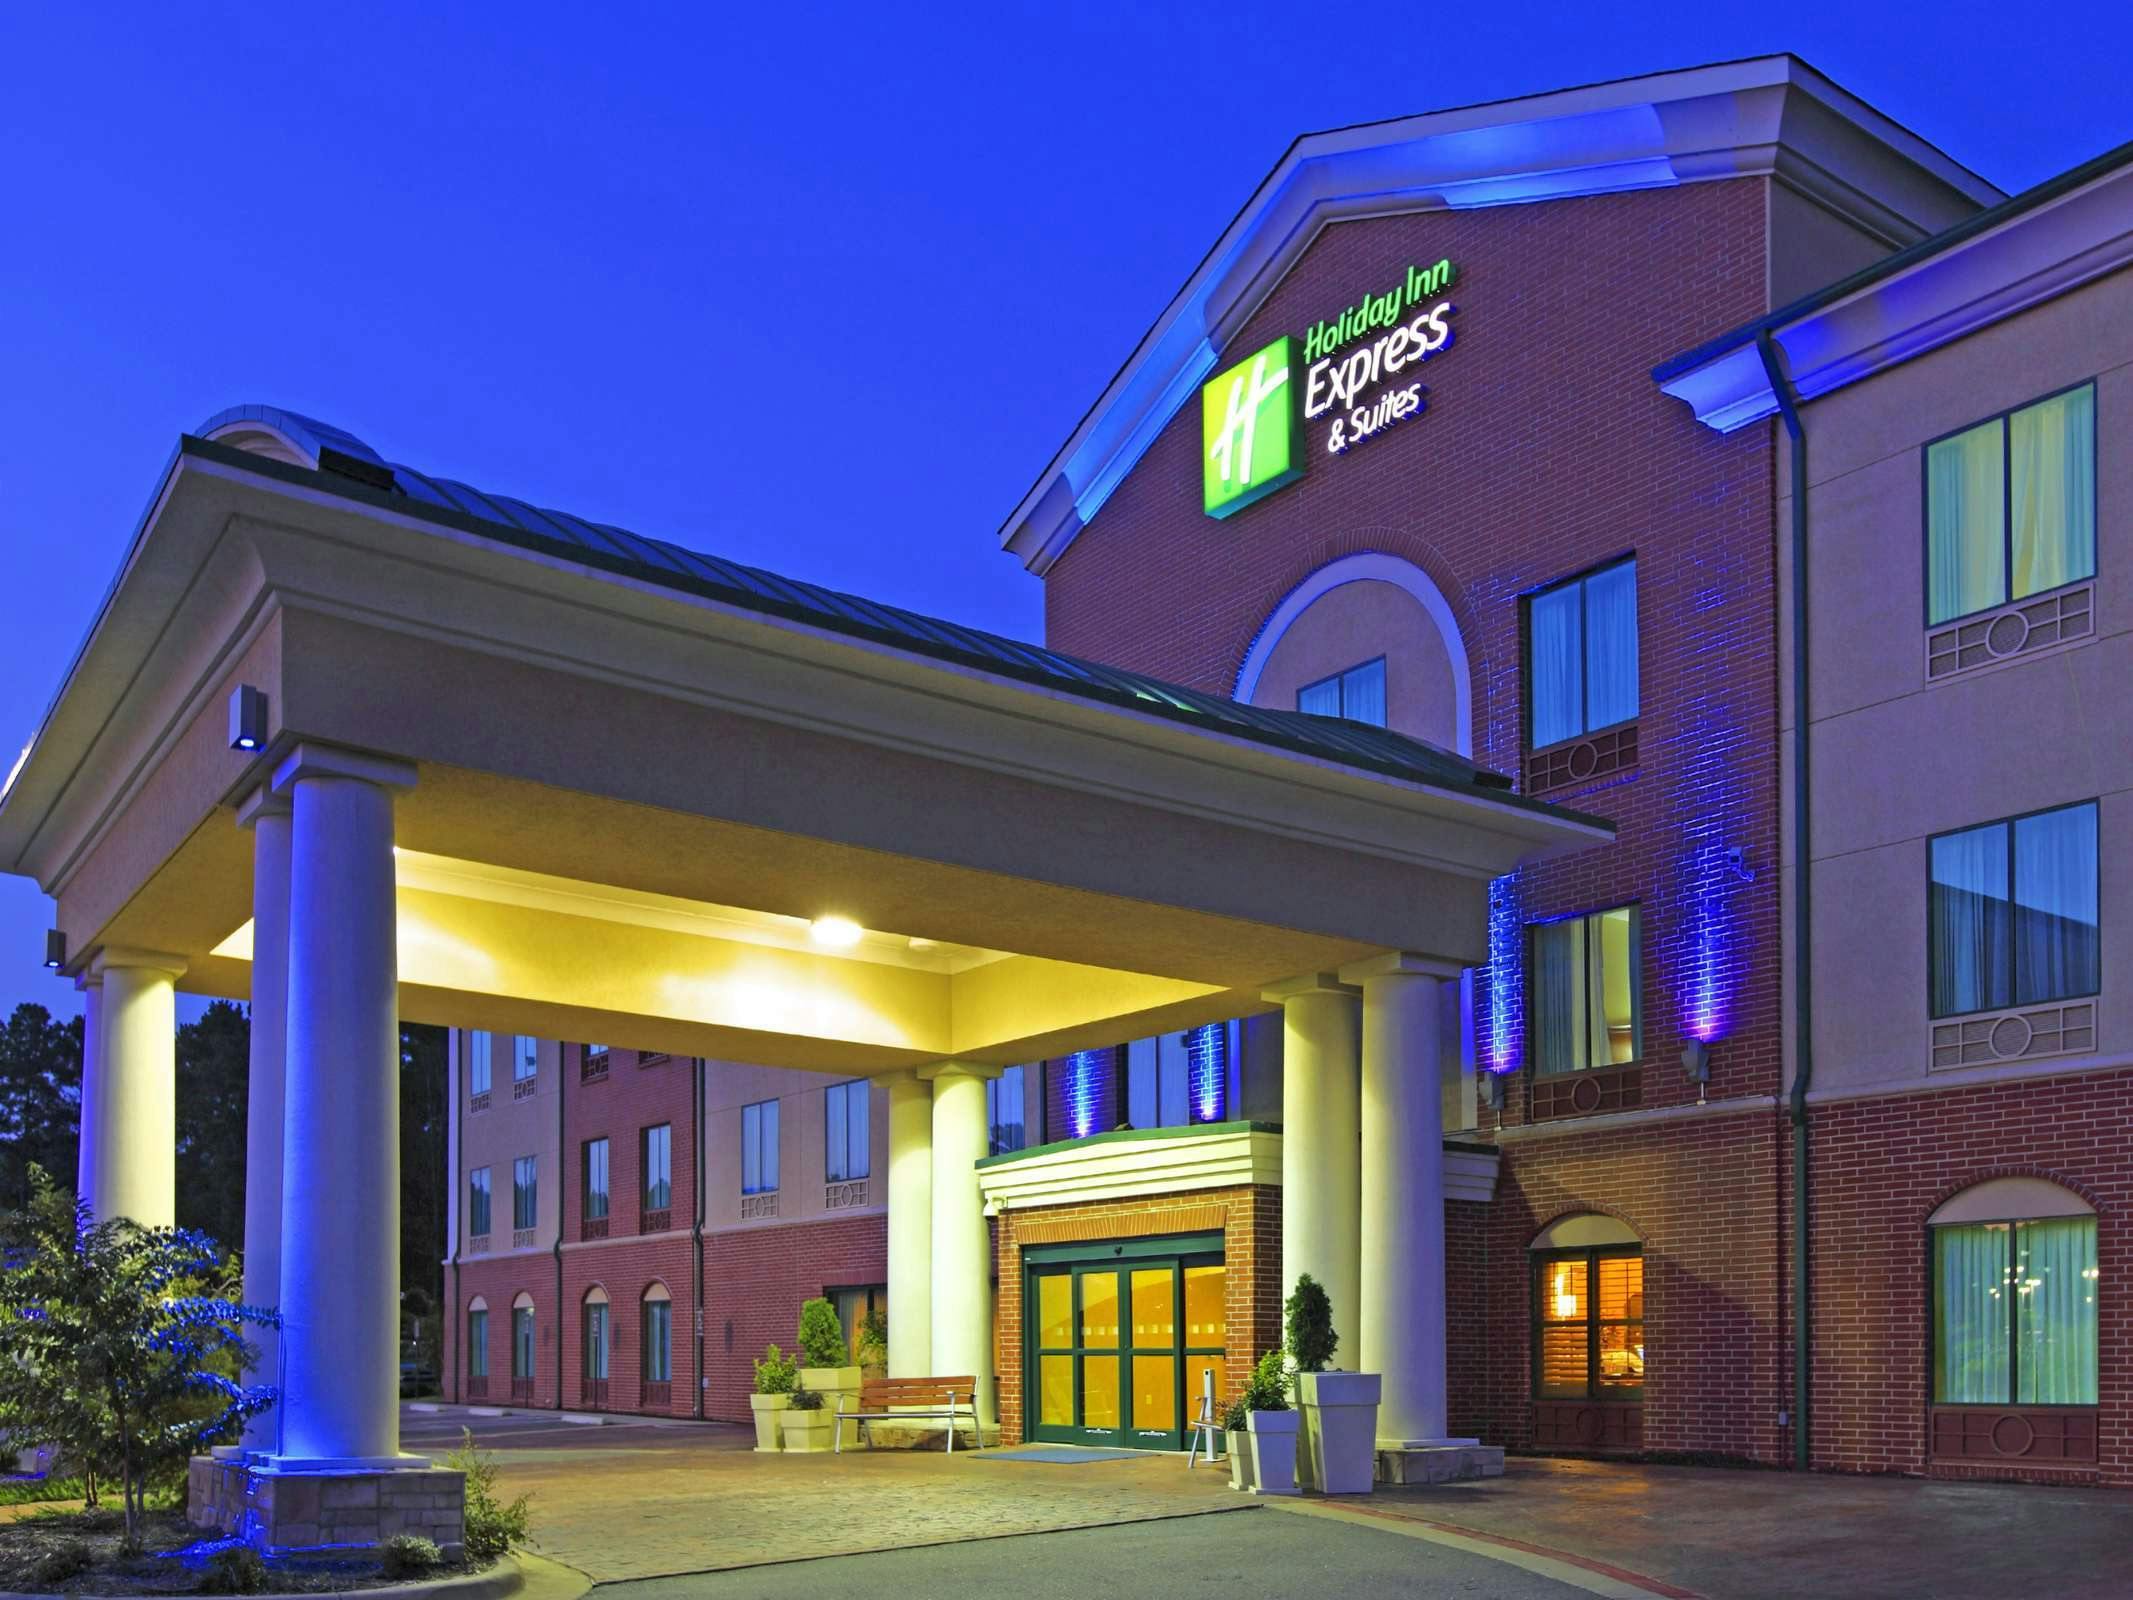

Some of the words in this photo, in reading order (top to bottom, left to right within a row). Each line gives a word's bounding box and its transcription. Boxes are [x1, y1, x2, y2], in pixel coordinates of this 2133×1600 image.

[1304, 287, 1402, 364] Holiday
[1406, 259, 1450, 305] Inn
[1304, 302, 1450, 419] Express
[1328, 419, 1346, 453] &
[1349, 383, 1421, 442] Suites
